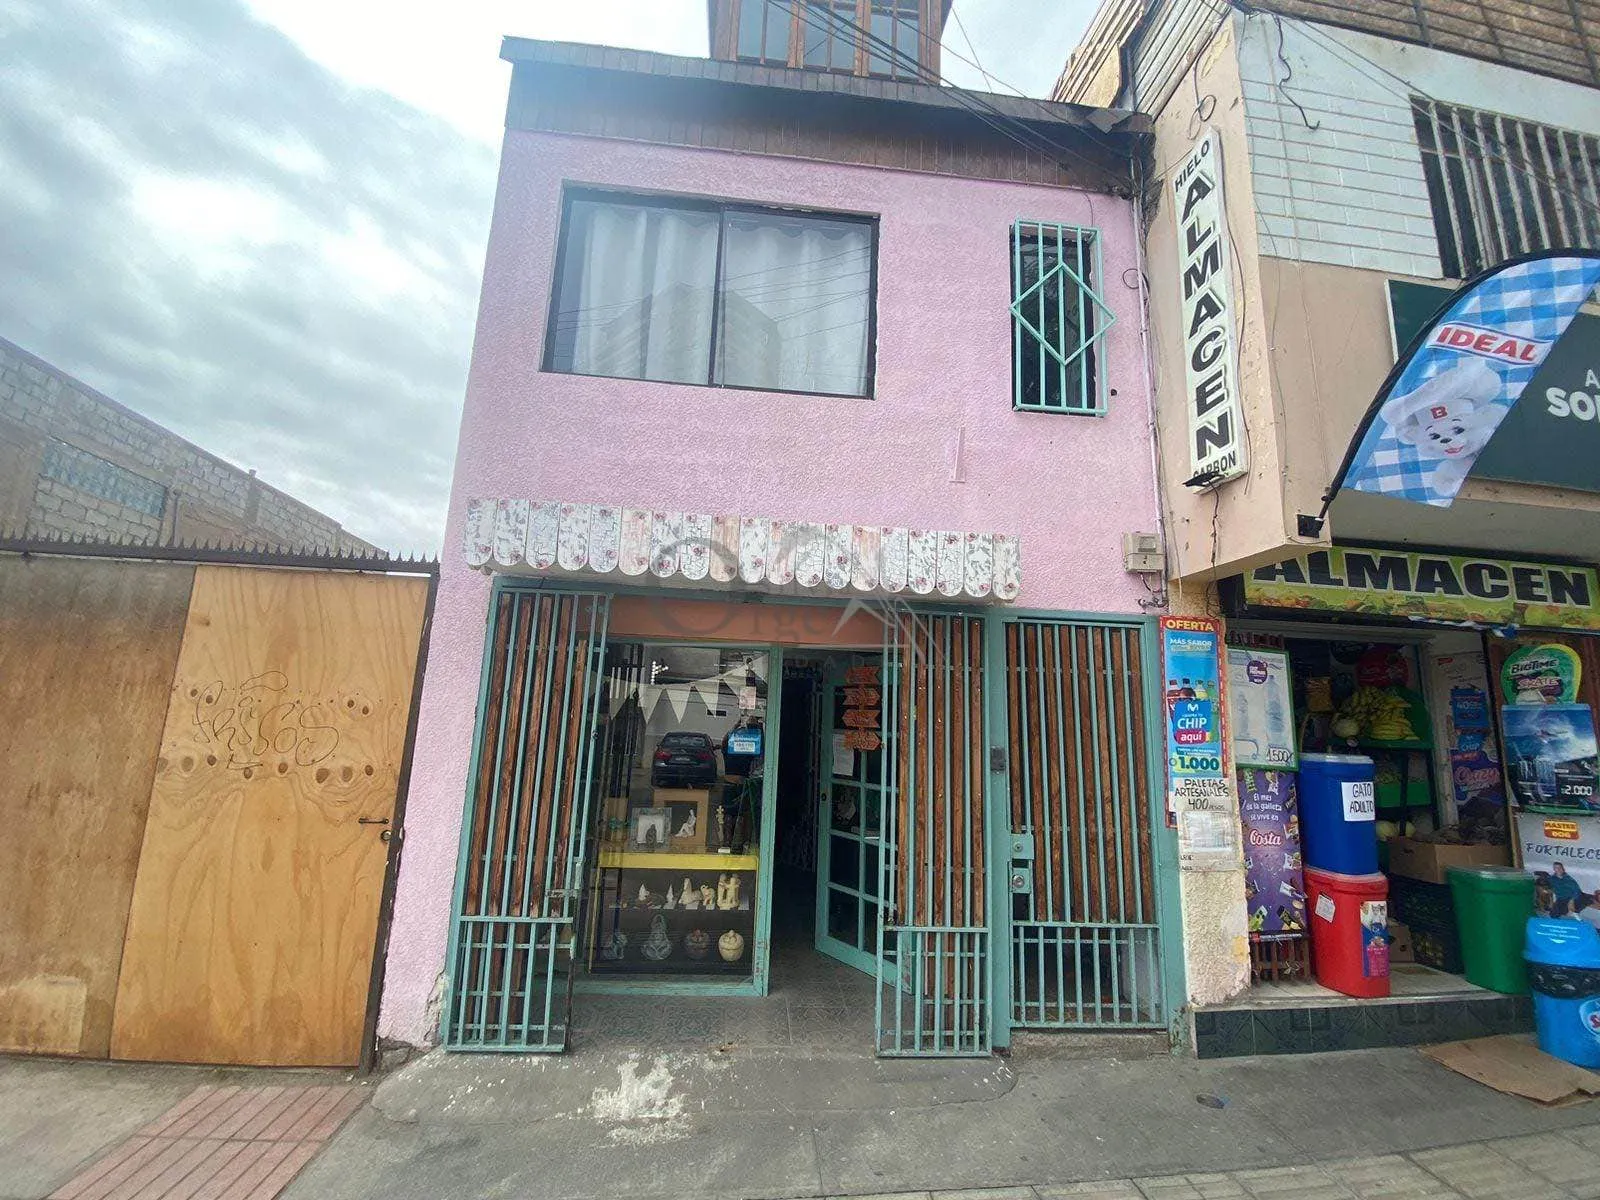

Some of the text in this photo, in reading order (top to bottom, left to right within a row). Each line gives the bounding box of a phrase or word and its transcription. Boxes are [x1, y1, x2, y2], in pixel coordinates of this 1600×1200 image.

[1174, 140, 1210, 193] HIELO
[1181, 175, 1231, 461] ALMACEN
[1436, 326, 1538, 362] IDEAL
[1252, 550, 1592, 608] ALMACEN
[1166, 619, 1215, 632] OFERTA
[1177, 717, 1207, 730] CHIP
[1180, 730, 1202, 744] aquí
[1179, 756, 1220, 771] 1.000
[1184, 778, 1226, 789] PALETAS
[1352, 783, 1372, 798] GATO
[1188, 798, 1209, 810] 400
[1350, 800, 1374, 813] ADULTO
[1249, 828, 1282, 846] Costa
